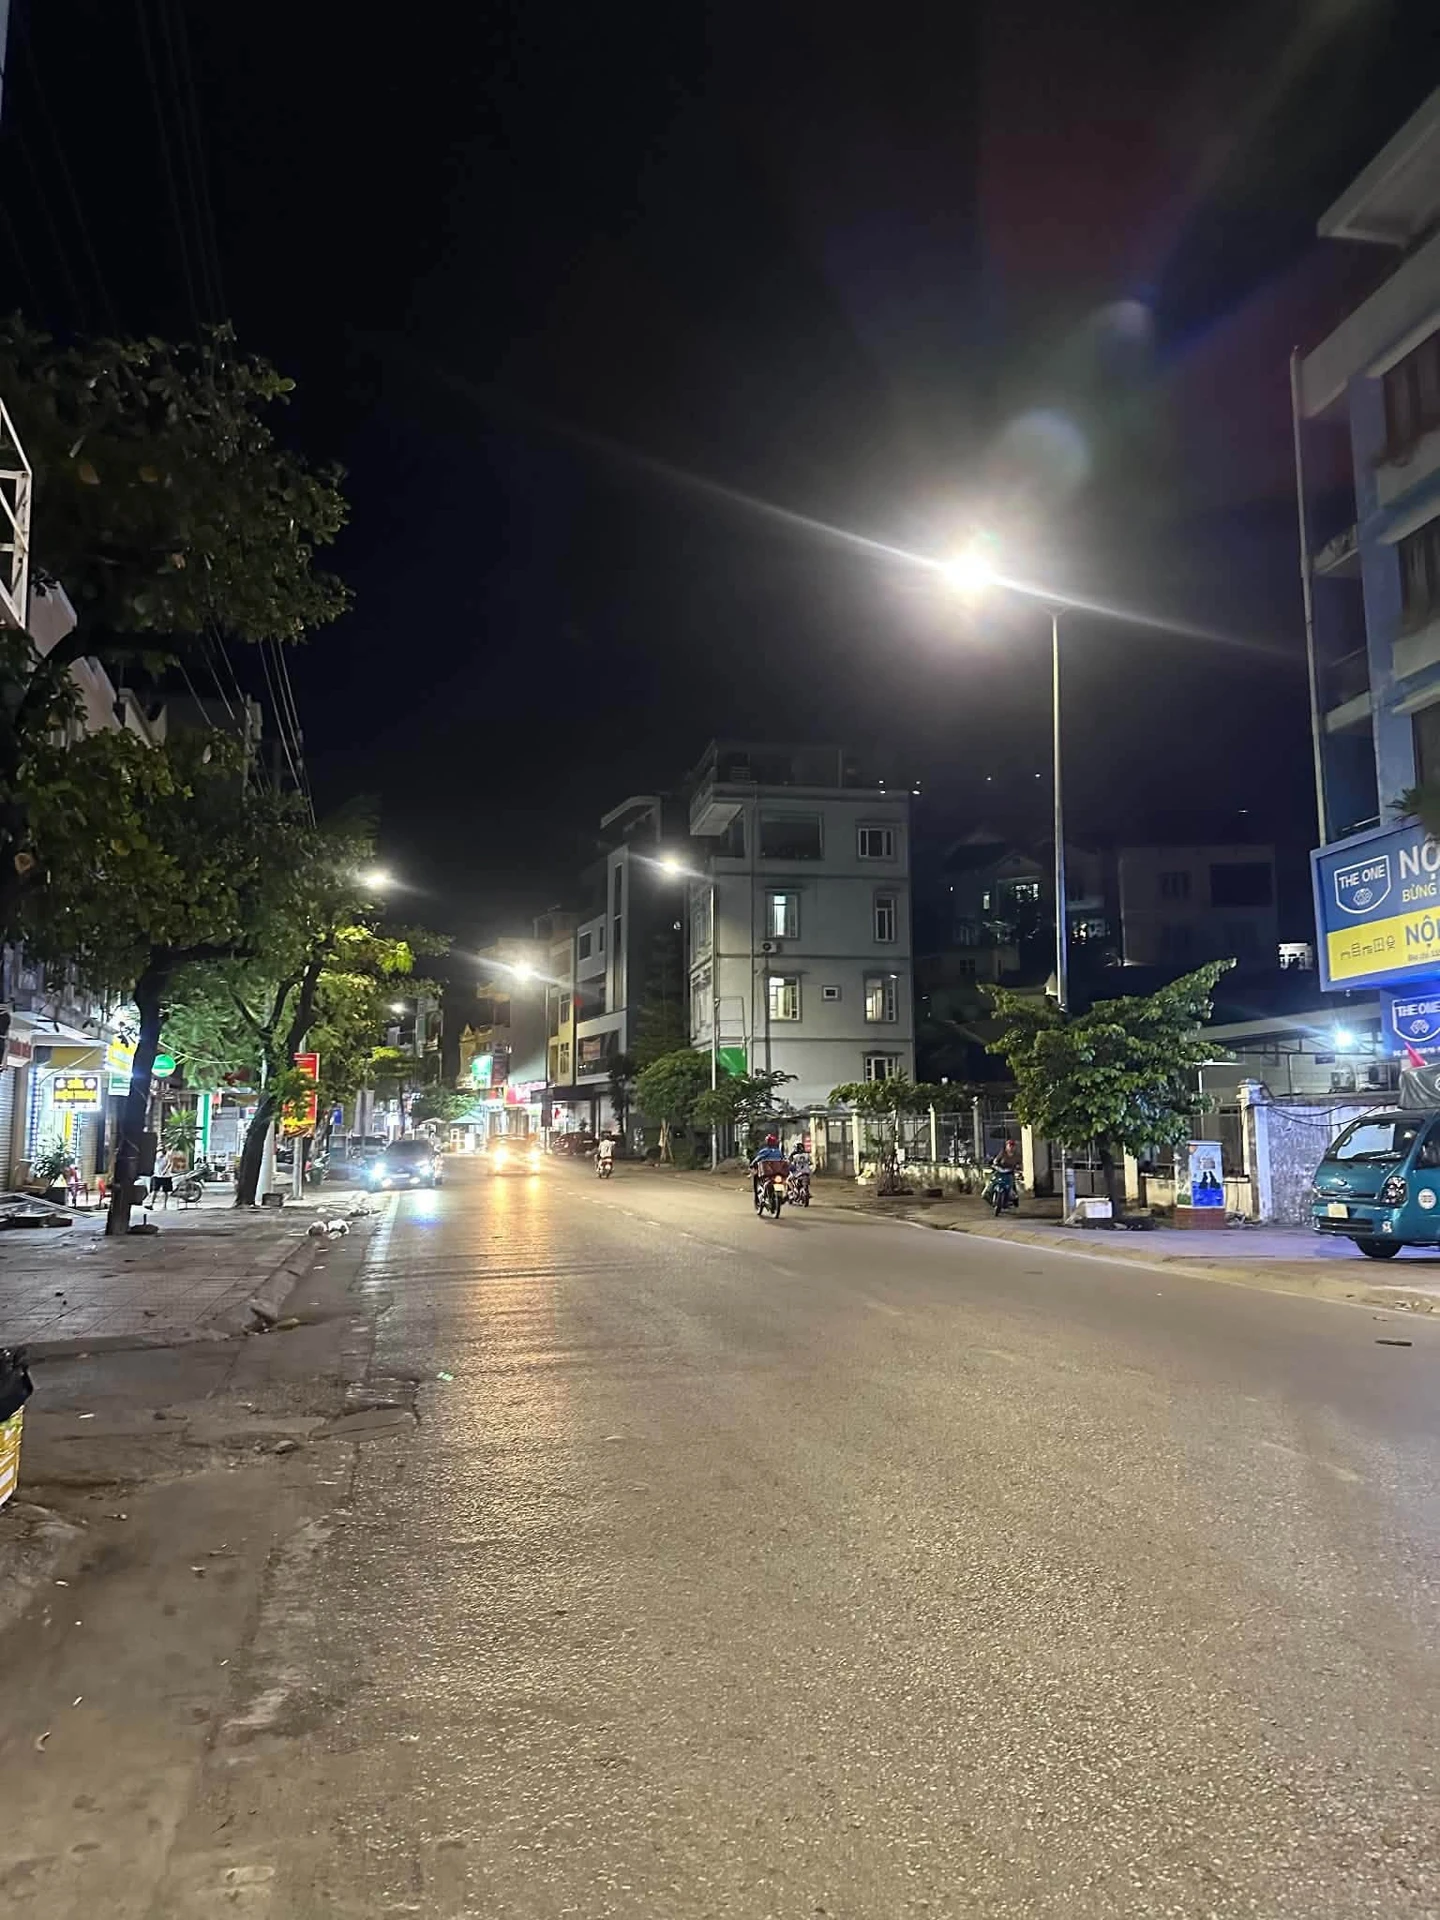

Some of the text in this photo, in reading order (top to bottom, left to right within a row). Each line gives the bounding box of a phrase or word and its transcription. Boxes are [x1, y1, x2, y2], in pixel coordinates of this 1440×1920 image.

[1339, 864, 1385, 889] THE ONE
[1395, 1001, 1440, 1017] THE ONE
